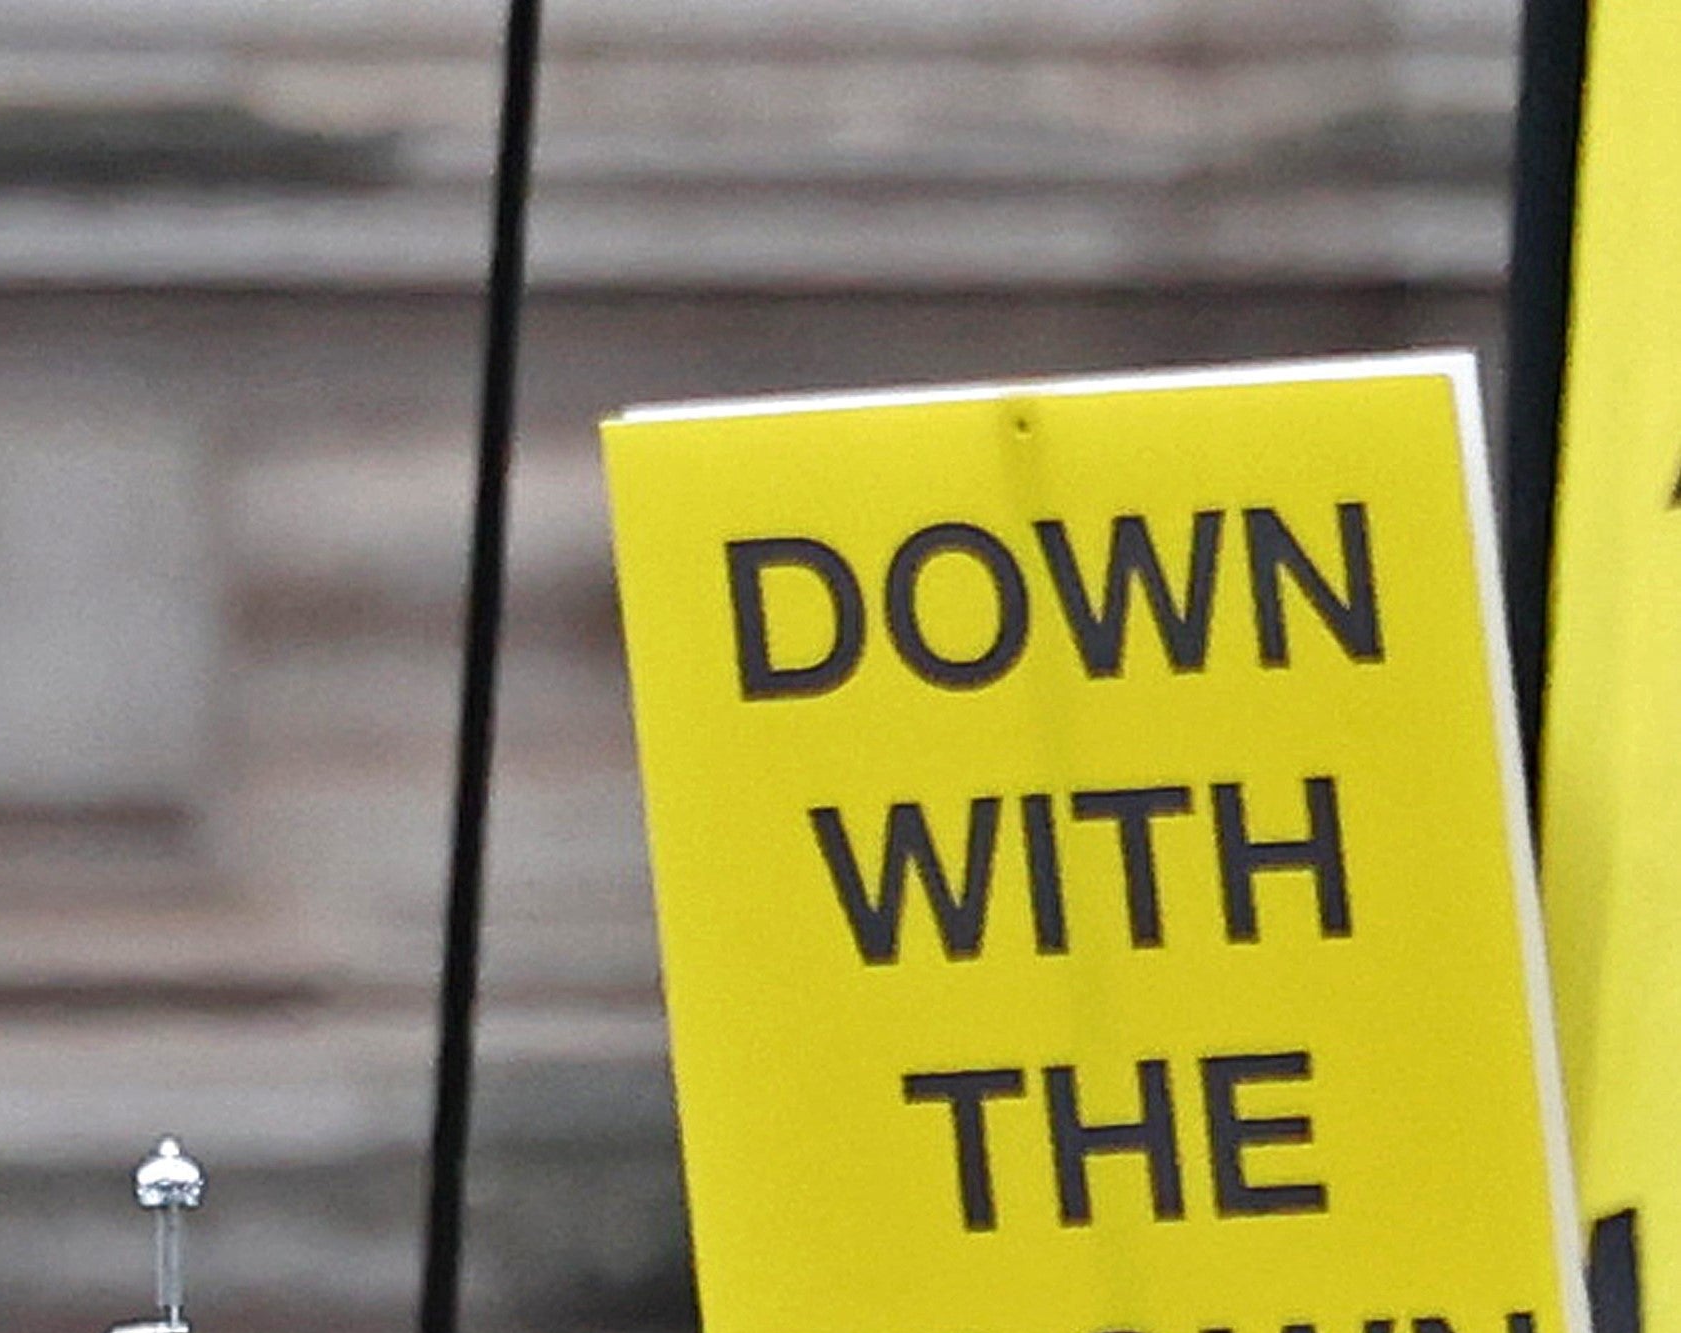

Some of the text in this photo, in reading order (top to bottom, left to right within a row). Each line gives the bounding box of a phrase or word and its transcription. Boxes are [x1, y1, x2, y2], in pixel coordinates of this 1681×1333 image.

[725, 503, 1384, 701] DOWN
[809, 776, 1351, 964] WITH
[902, 1051, 1327, 1231] THE
